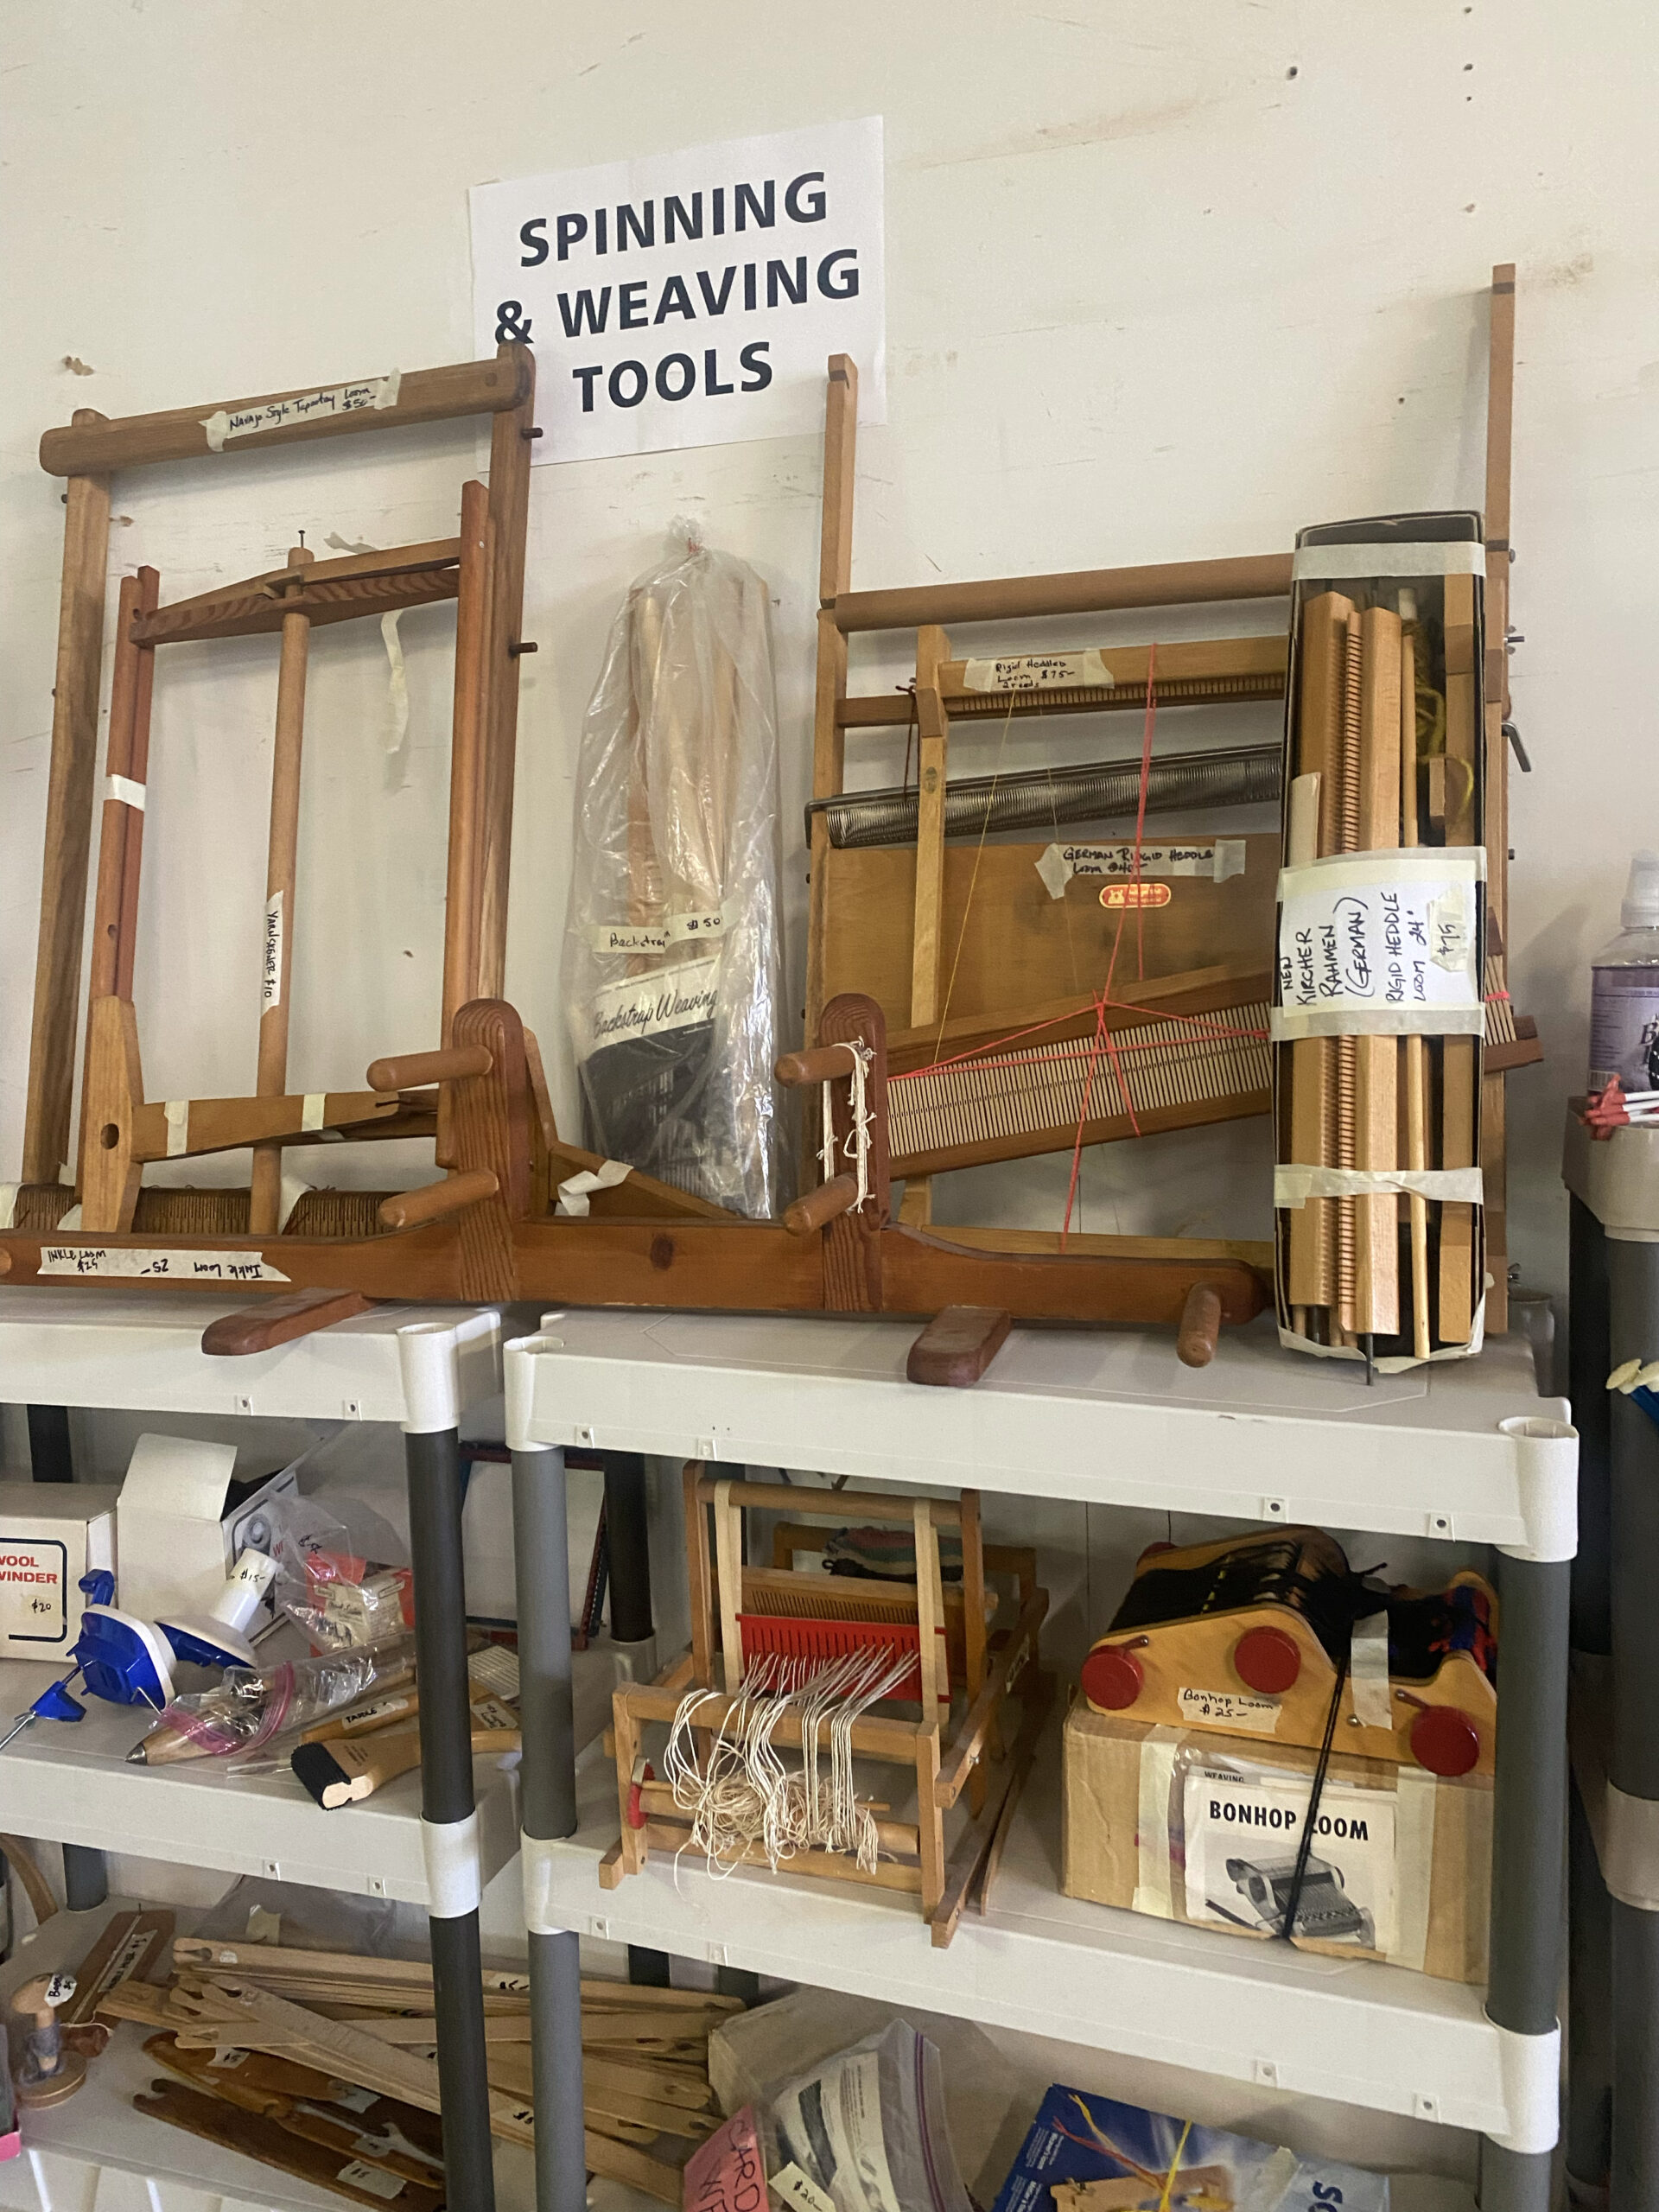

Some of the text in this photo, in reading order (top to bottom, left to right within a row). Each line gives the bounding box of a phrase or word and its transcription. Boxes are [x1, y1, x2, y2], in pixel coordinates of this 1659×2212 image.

[519, 171, 827, 267] SPINNING
[494, 249, 860, 345] & WEAVING
[572, 341, 773, 413] TOOLS
[995, 661, 1021, 675] Rigid
[997, 673, 1032, 683] Loom
[1063, 847, 1114, 861] GERMAN
[267, 910, 280, 937] YARN
[1437, 924, 1461, 956] $75
[1296, 927, 1317, 1006] KIRCHER
[1319, 924, 1344, 998] RAHMEN
[1332, 896, 1376, 998] (GERMAN)
[1381, 891, 1407, 1004] RIGID HEDDLE
[593, 989, 718, 1041] Backstrap Weaving
[48, 1249, 77, 1263] INKLE
[31, 1598, 52, 1614] $20
[1183, 1688, 1274, 1711] Bonhop Loom
[1204, 1770, 1245, 1783] WEAVING
[1209, 1800, 1369, 1842] BONHOP OOM
[728, 2120, 760, 2212] CARD
